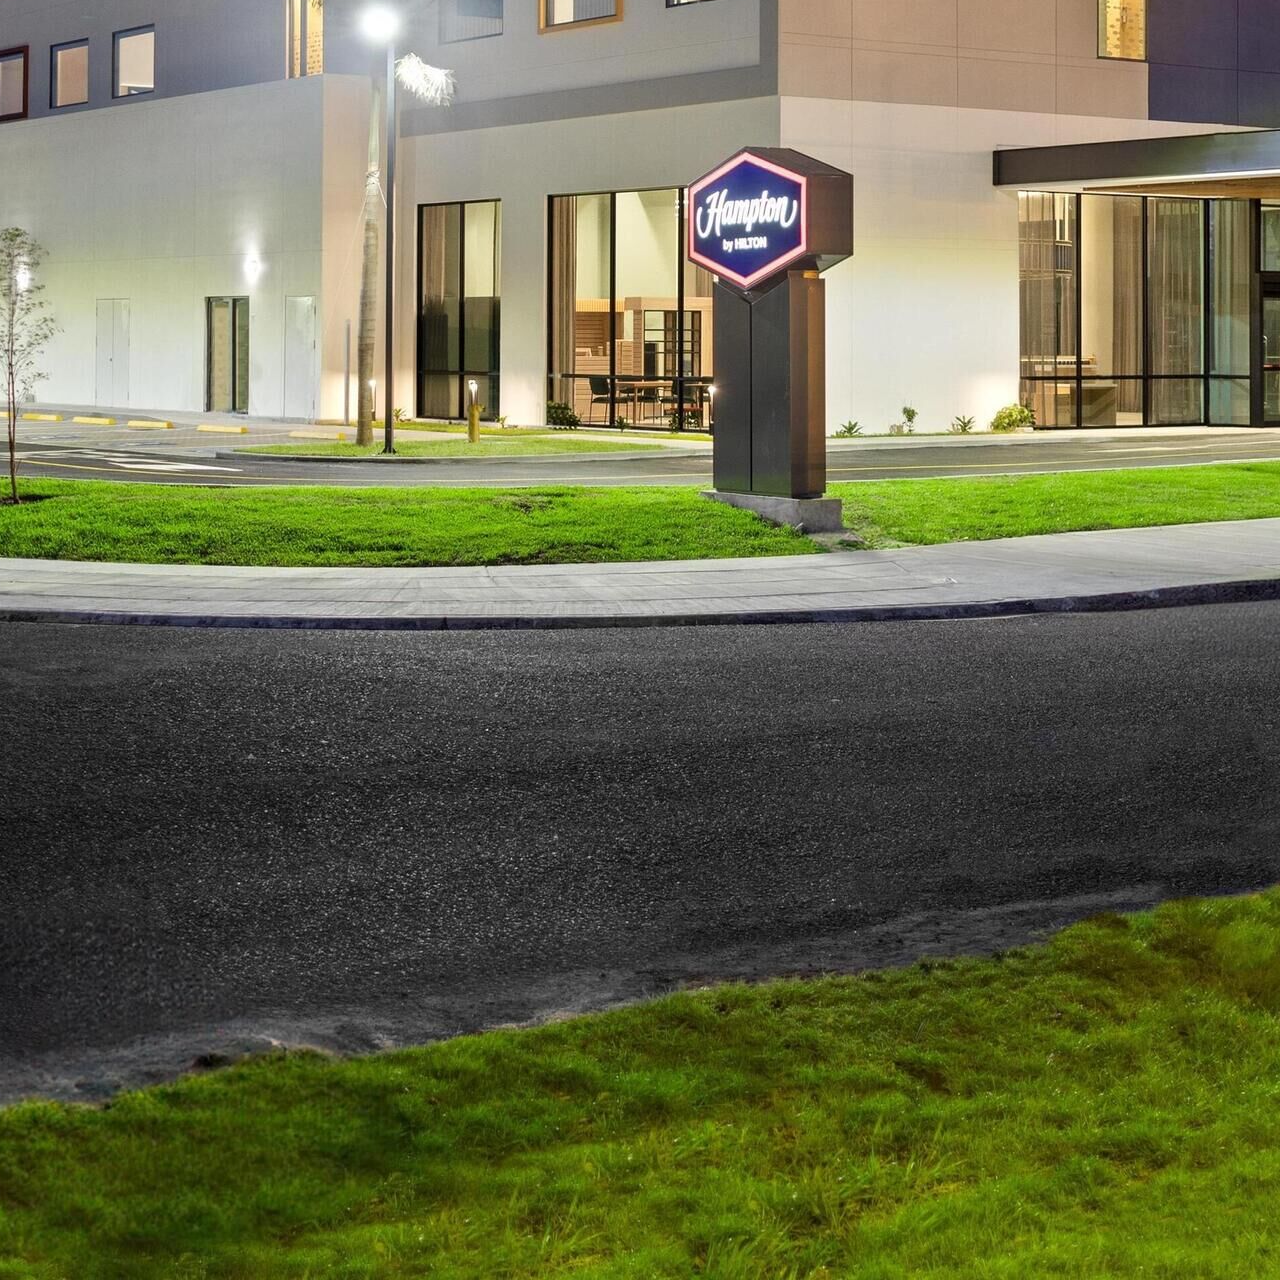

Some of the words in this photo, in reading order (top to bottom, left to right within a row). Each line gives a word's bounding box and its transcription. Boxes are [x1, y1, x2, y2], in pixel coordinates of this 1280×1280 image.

[696, 188, 798, 239] Hampton
[722, 238, 733, 253] by
[734, 236, 768, 250] HILTON
